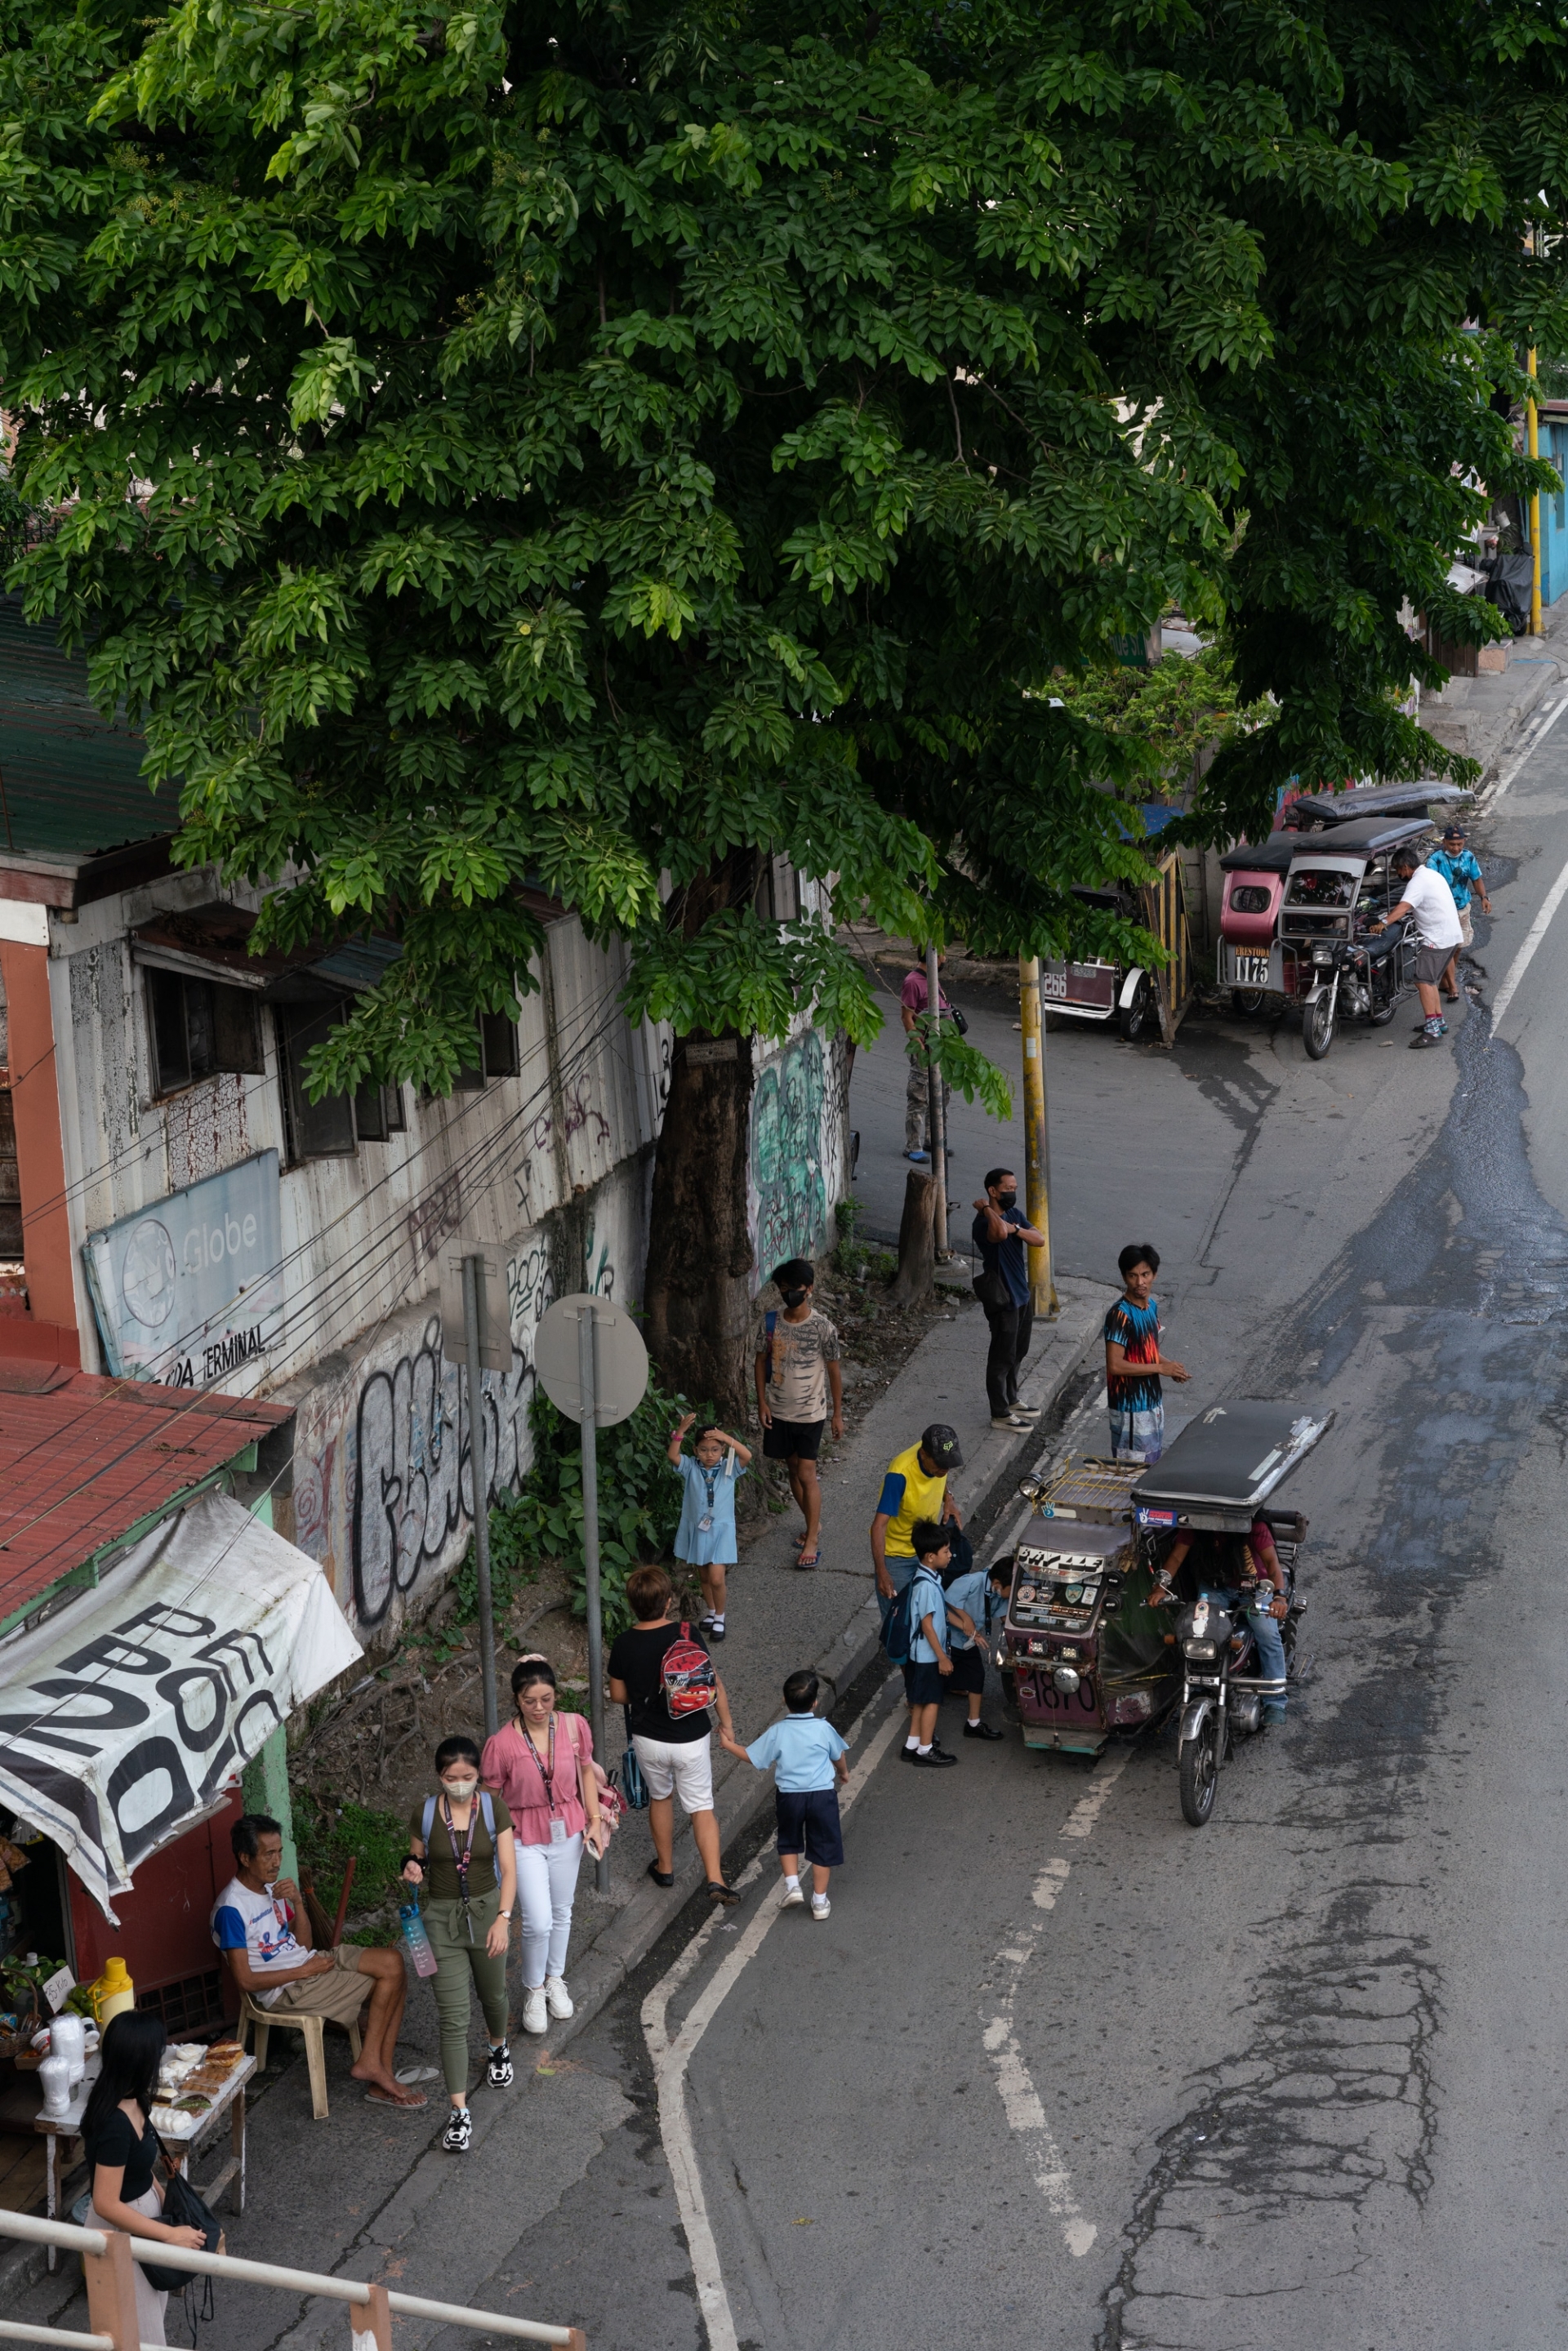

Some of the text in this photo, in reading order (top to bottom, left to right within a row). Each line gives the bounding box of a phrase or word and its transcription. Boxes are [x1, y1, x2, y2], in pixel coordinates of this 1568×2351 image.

[1235, 946, 1270, 958] ERESTODA
[1236, 956, 1268, 983] 1175
[185, 1212, 257, 1274] Globe
[202, 1325, 265, 1382] TERMINAL
